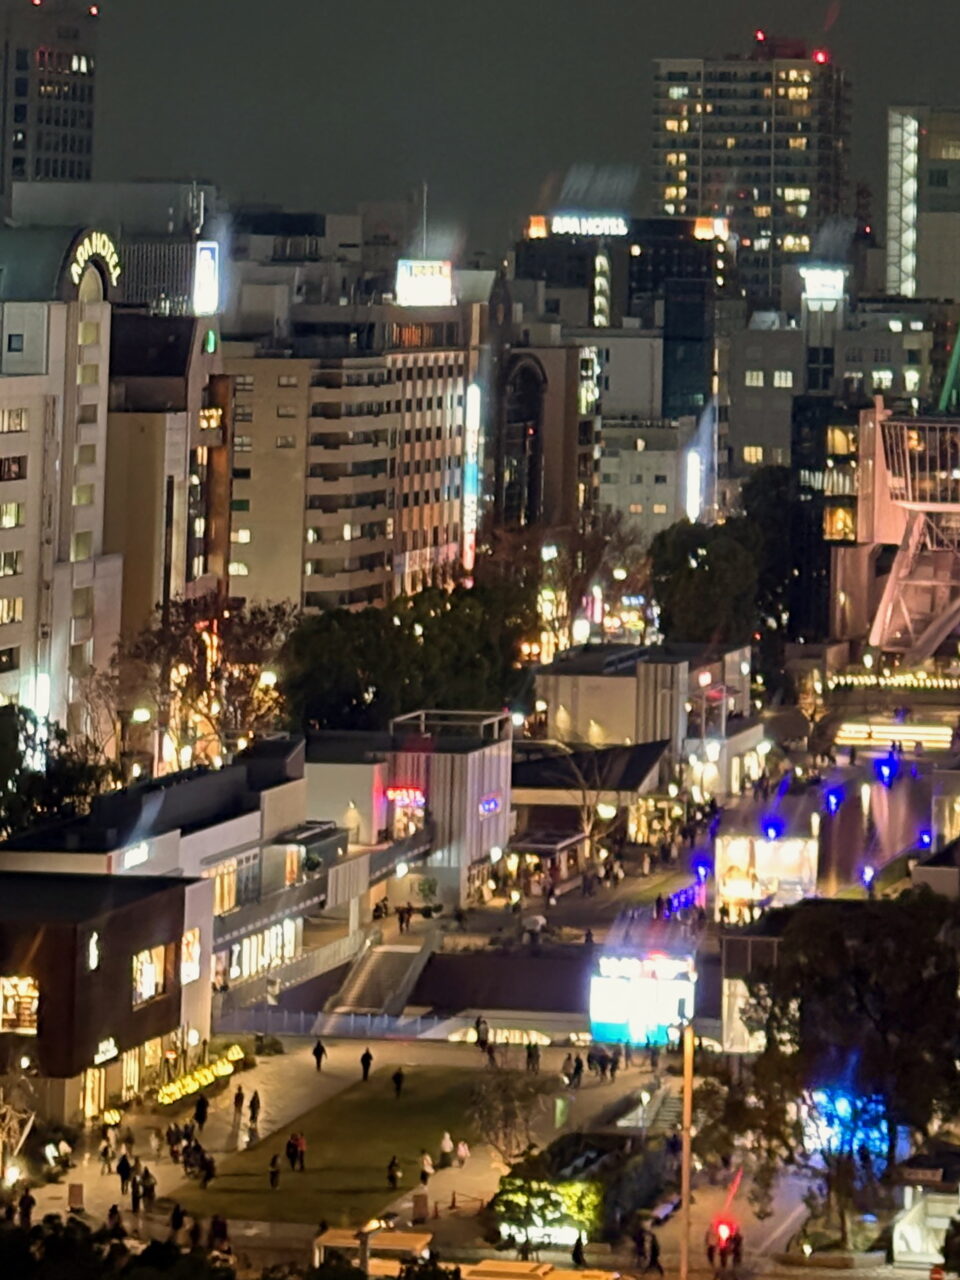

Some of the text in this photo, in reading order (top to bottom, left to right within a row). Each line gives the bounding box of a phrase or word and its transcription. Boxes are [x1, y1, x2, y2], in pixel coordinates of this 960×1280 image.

[552, 217, 628, 235] APA HOTEL
[71, 231, 121, 287] APA HOTEL
